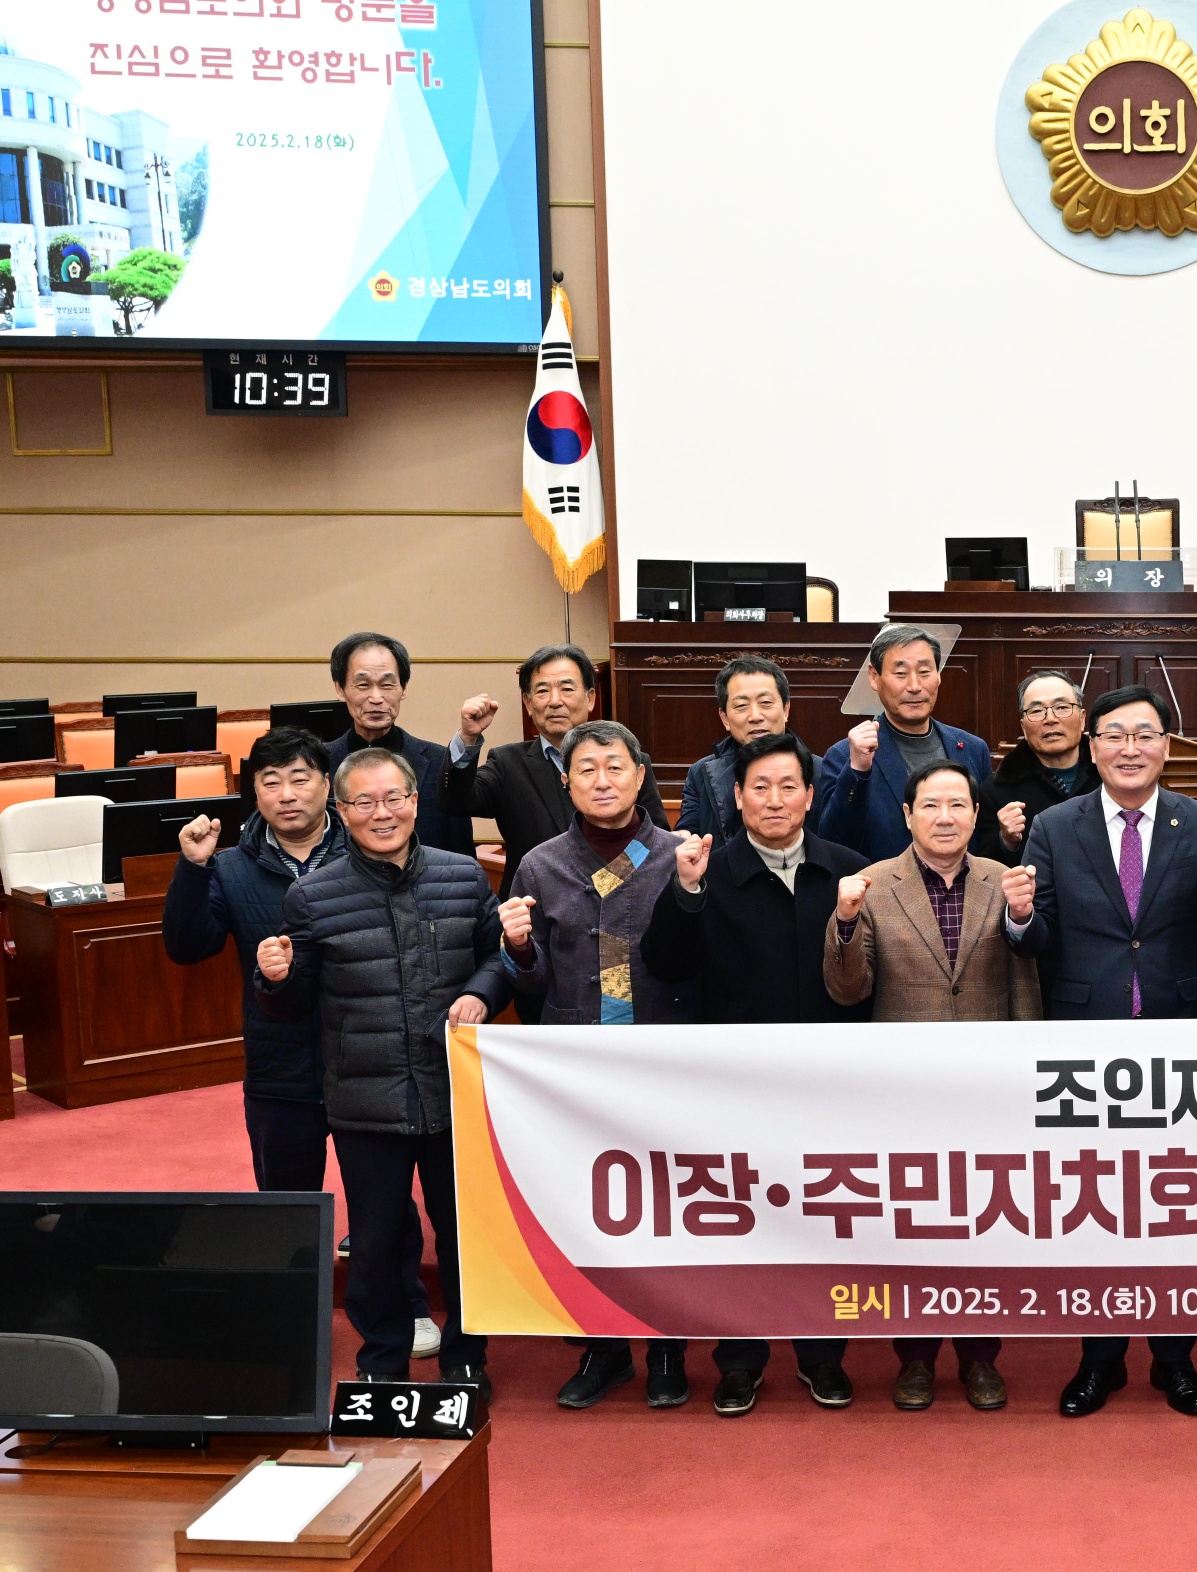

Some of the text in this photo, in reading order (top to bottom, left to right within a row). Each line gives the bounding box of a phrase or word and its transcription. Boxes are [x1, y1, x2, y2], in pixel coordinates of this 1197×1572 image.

[89, 43, 442, 88] 진심으로 환영합니다.
[235, 132, 355, 152] 2025.2.18(화)
[1083, 98, 1186, 154] 의회
[376, 282, 392, 292] 의회
[407, 276, 532, 301] 경상남도의회
[234, 372, 330, 406] 10:39
[829, 1283, 891, 1320] 일시
[921, 1286, 1010, 1316] 2025.
[1020, 1288, 1046, 1316] 2.
[1057, 1285, 1157, 1321] 18.(화)
